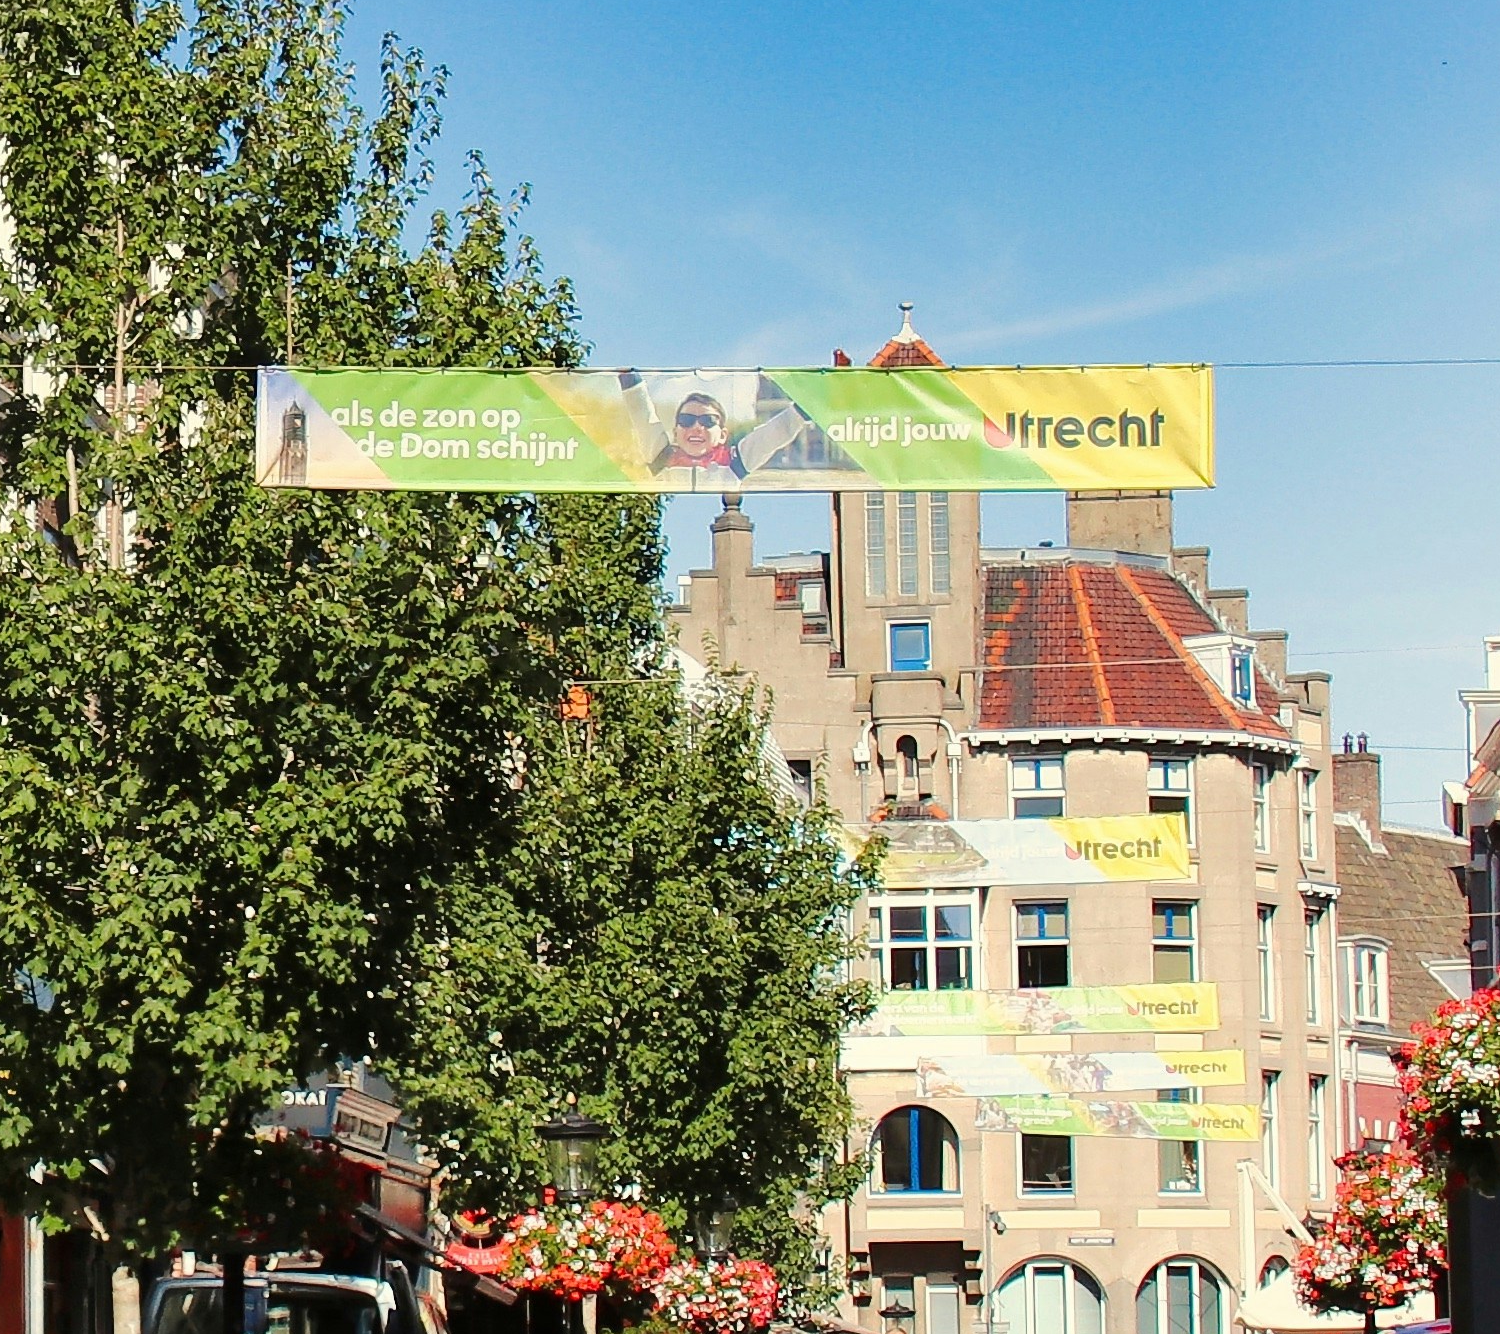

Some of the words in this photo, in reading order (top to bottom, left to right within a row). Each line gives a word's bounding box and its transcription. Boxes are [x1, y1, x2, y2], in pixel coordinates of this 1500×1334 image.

[331, 400, 373, 427] als
[379, 401, 417, 427] de
[422, 408, 475, 427] zon
[482, 408, 521, 434] op
[826, 417, 897, 447] altijd
[903, 417, 973, 448] jouw
[983, 407, 1165, 448] Utrecht
[354, 431, 395, 458] de
[400, 433, 470, 458] Dom
[477, 432, 578, 467] schijnt
[1065, 836, 1162, 860] Utrecht
[1127, 1000, 1198, 1016] Utrecht
[1190, 1115, 1246, 1131] Utrecht
